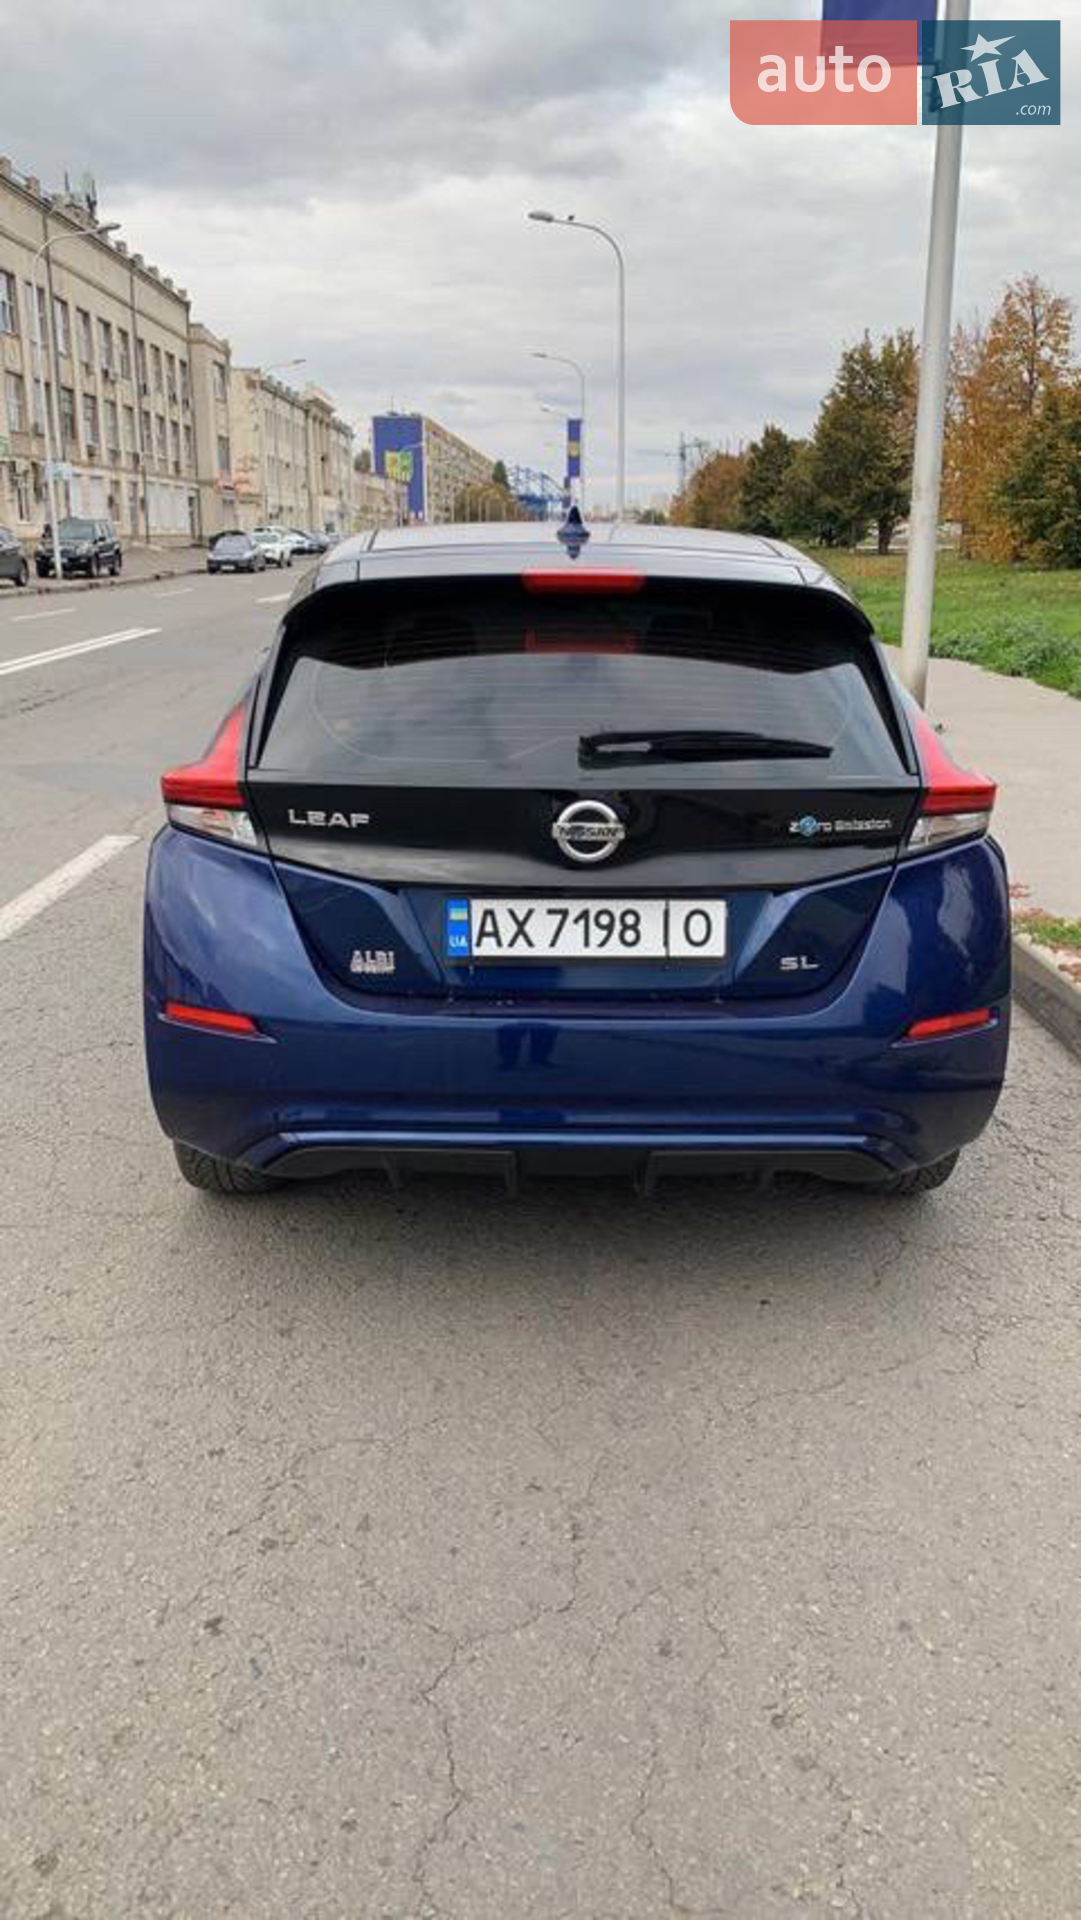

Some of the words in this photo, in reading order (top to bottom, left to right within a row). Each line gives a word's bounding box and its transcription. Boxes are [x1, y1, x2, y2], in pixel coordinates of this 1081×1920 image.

[287, 808, 370, 828] LEAF
[449, 935, 468, 948] UA
[779, 956, 820, 971] SL
